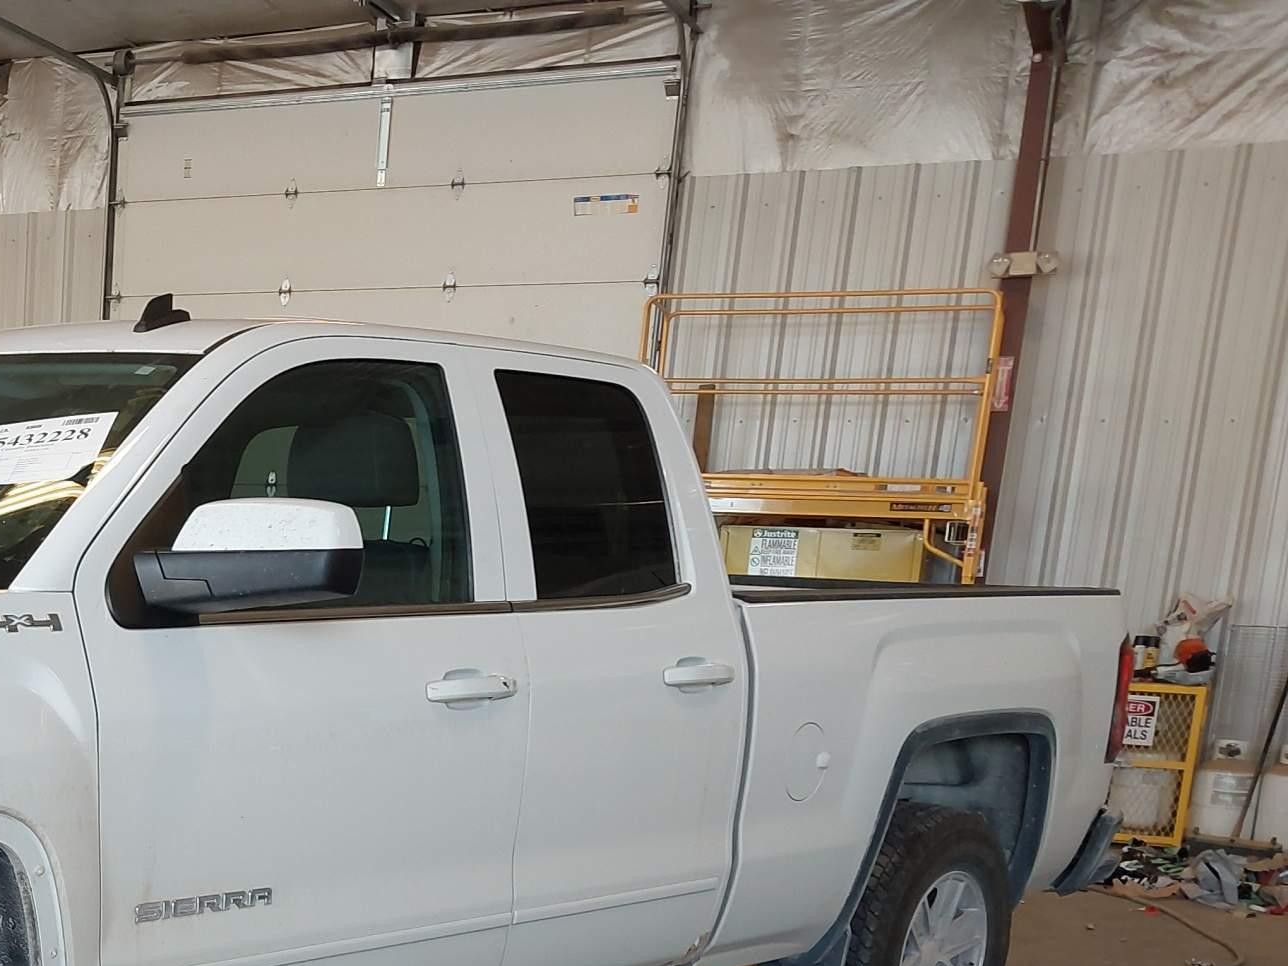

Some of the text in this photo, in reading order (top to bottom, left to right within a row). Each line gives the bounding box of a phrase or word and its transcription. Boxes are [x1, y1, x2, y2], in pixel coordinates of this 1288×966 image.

[762, 529, 797, 538] Justrite
[761, 539, 797, 550] FLAMMABLE
[1127, 703, 1146, 713] ER
[135, 887, 273, 924] SIERRA
